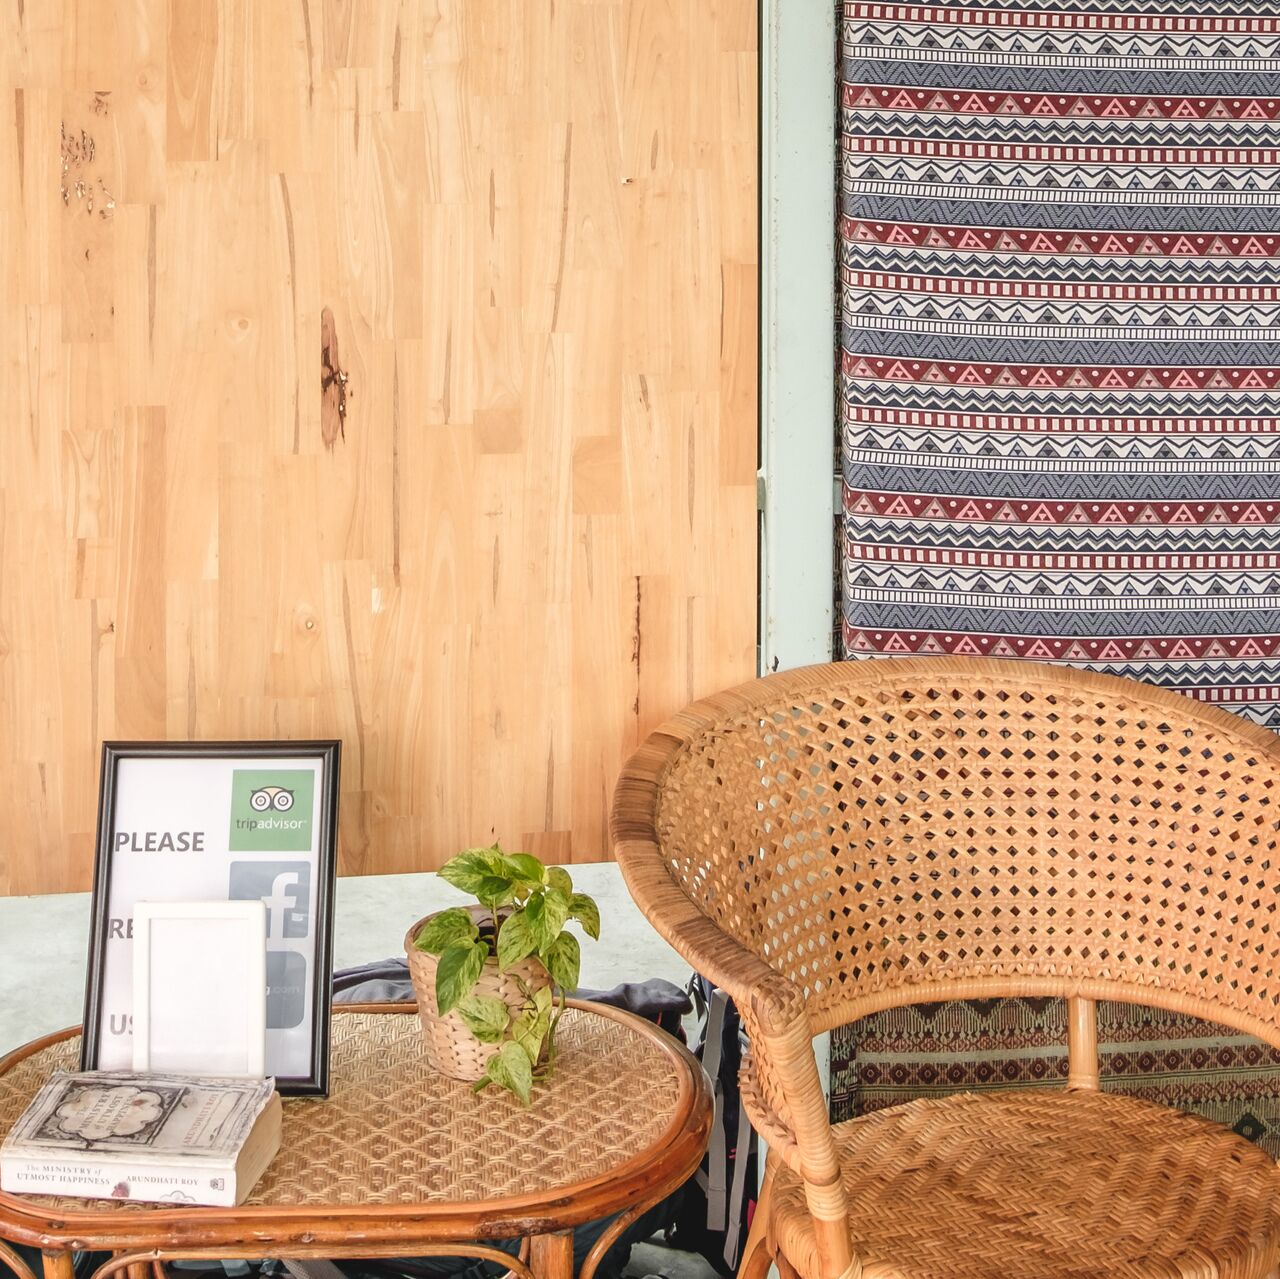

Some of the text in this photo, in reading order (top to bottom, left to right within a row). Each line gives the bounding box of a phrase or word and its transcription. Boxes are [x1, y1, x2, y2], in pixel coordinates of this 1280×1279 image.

[236, 817, 303, 831] tripadvisor
[115, 831, 205, 853] PLEASE
[42, 1165, 92, 1175] MINISTRY
[17, 1172, 111, 1186] UTMOST HAPPINESS
[126, 1175, 199, 1186] ARUNDHATI ROY
